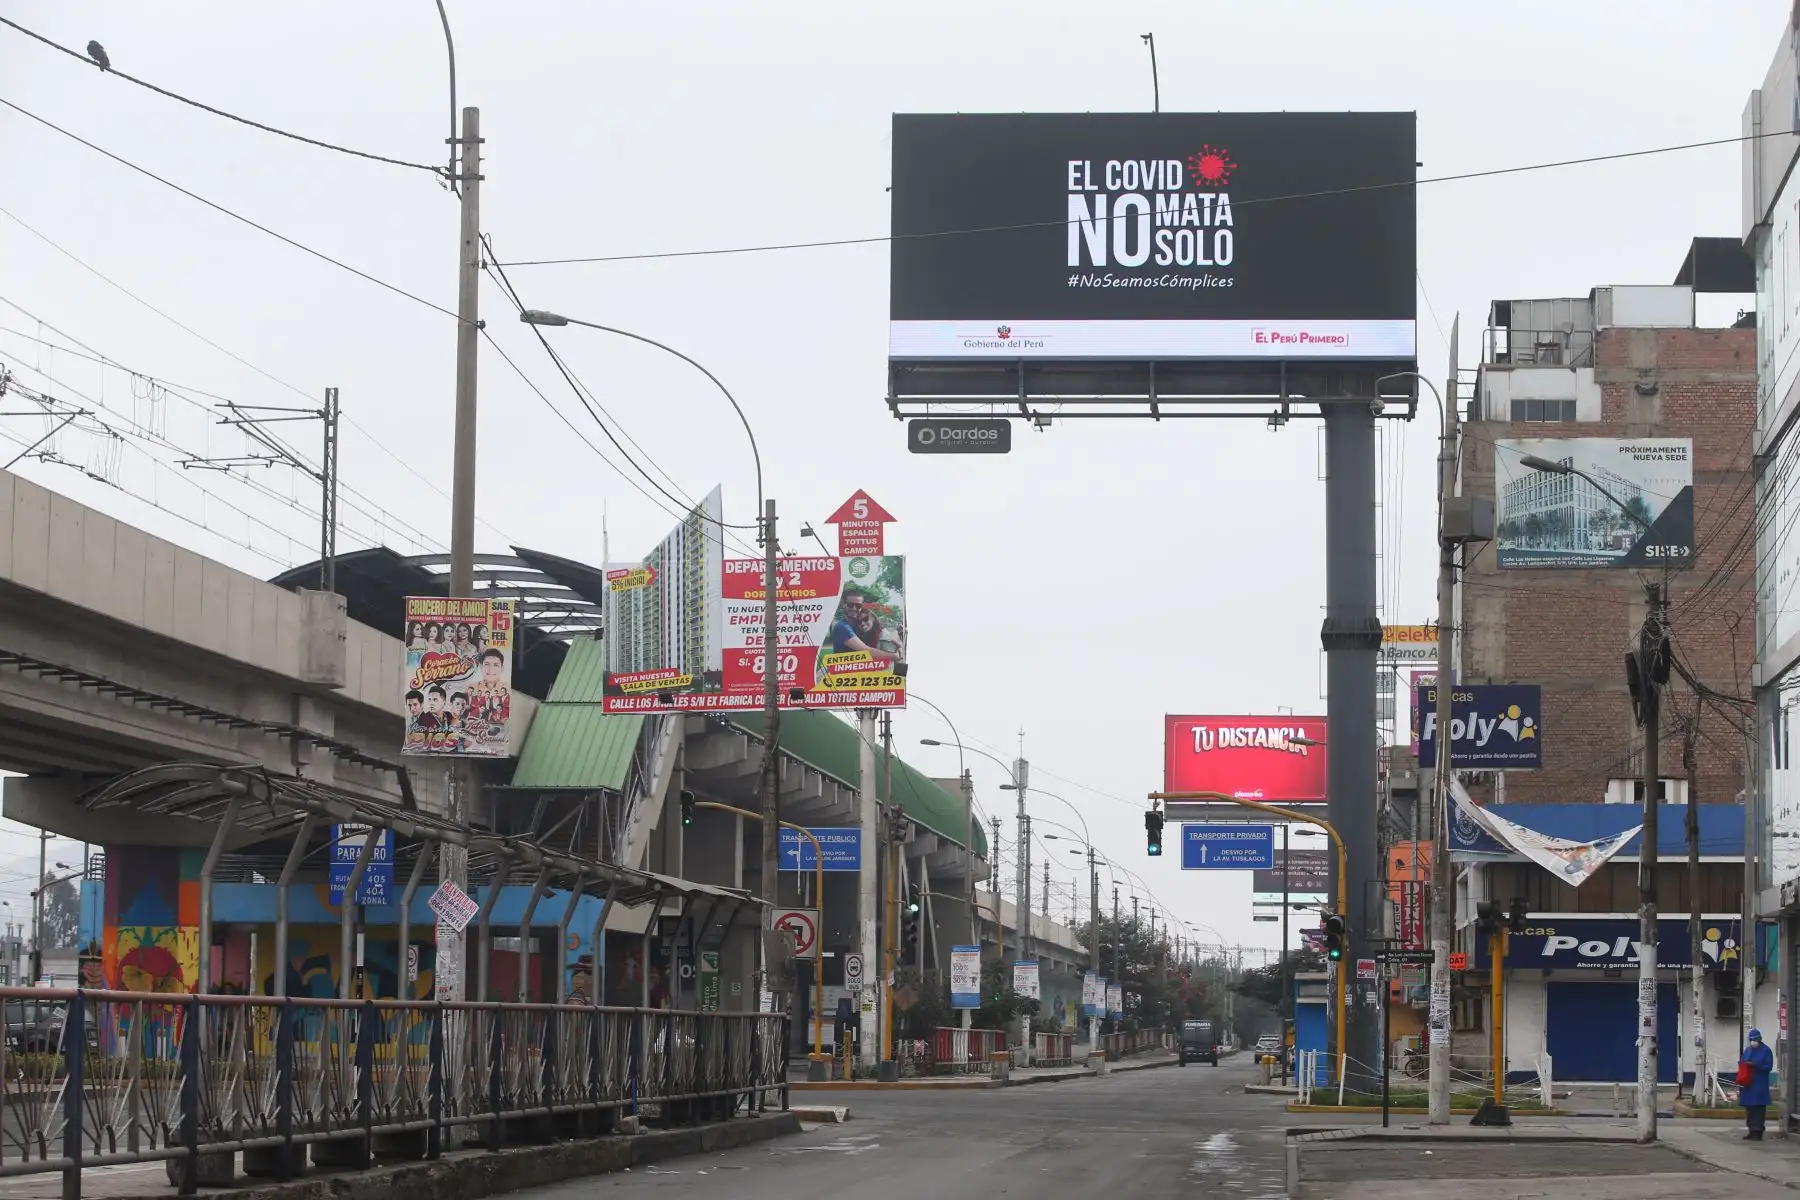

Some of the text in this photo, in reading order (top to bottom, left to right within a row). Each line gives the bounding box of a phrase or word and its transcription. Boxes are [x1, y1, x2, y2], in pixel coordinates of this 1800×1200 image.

[1068, 159, 1183, 190] EL COVID
[1155, 193, 1233, 227] MATA
[1067, 193, 1151, 267] NO
[1154, 229, 1233, 266] SOLO
[1068, 273, 1233, 291] #NoSeamosCómplices
[963, 339, 1044, 349] Gobierno del Perú
[940, 427, 998, 440] Dardos
[853, 499, 868, 519] 5
[843, 529, 879, 537] ESPALDA
[1645, 545, 1679, 557] SISE
[725, 559, 834, 574] DEPARAMENTOS
[776, 576, 783, 588] y
[789, 572, 800, 586] 2
[744, 589, 817, 598] DORITORIOS
[408, 600, 446, 616] CRUCERO
[447, 600, 460, 616] DEL
[461, 601, 486, 617] AMOR
[490, 612, 511, 631] 15
[793, 613, 821, 623] HOY
[777, 625, 809, 633] PROPIO
[491, 632, 508, 640] FEB.
[745, 634, 805, 646] DEA YA!
[827, 653, 867, 664] ENTREGA
[1387, 647, 1426, 658] Banco
[834, 661, 885, 672] INMEDIATA
[614, 671, 675, 684] VISITA NUESTRA
[623, 677, 690, 690] SALA DE VENTAS
[836, 676, 902, 687] 922 123 150
[610, 698, 635, 709] CALLE
[636, 697, 652, 708] LOS
[706, 696, 718, 706] EX
[719, 695, 753, 706] FABRICA
[828, 691, 857, 703] TOTTUS
[859, 692, 896, 704] CAMPOY)
[1428, 690, 1474, 702] Bcas
[1218, 726, 1308, 756] DISTANCIA
[337, 847, 386, 861] PARARO
[361, 897, 387, 905] ZONAL
